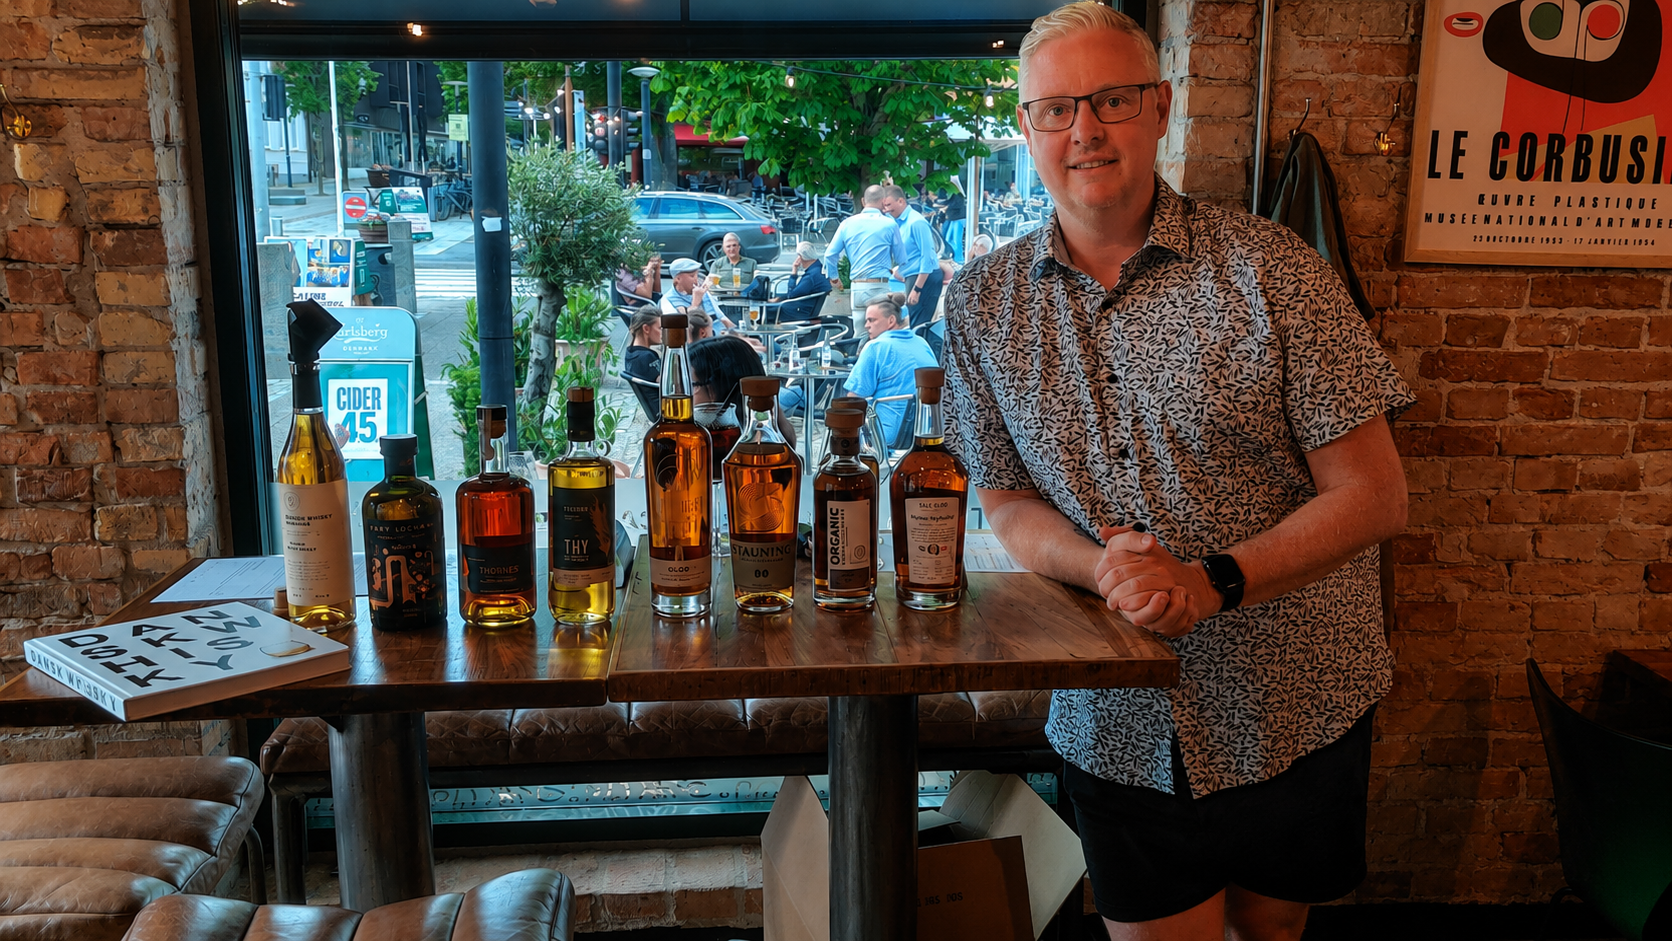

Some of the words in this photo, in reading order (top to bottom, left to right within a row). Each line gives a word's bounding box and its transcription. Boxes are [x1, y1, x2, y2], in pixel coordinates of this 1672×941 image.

[1427, 130, 1468, 180] LE
[1489, 131, 1672, 185] CORBUSI
[1554, 195, 1657, 210] PLASTIQUE
[1483, 214, 1568, 226] NATIONAL
[335, 323, 388, 340] arlsberg
[336, 386, 382, 411] CIDER
[829, 507, 841, 566] ORGANIC
[564, 538, 589, 555] THY
[731, 543, 792, 558] STAUNING
[30, 649, 64, 680] DANSK
